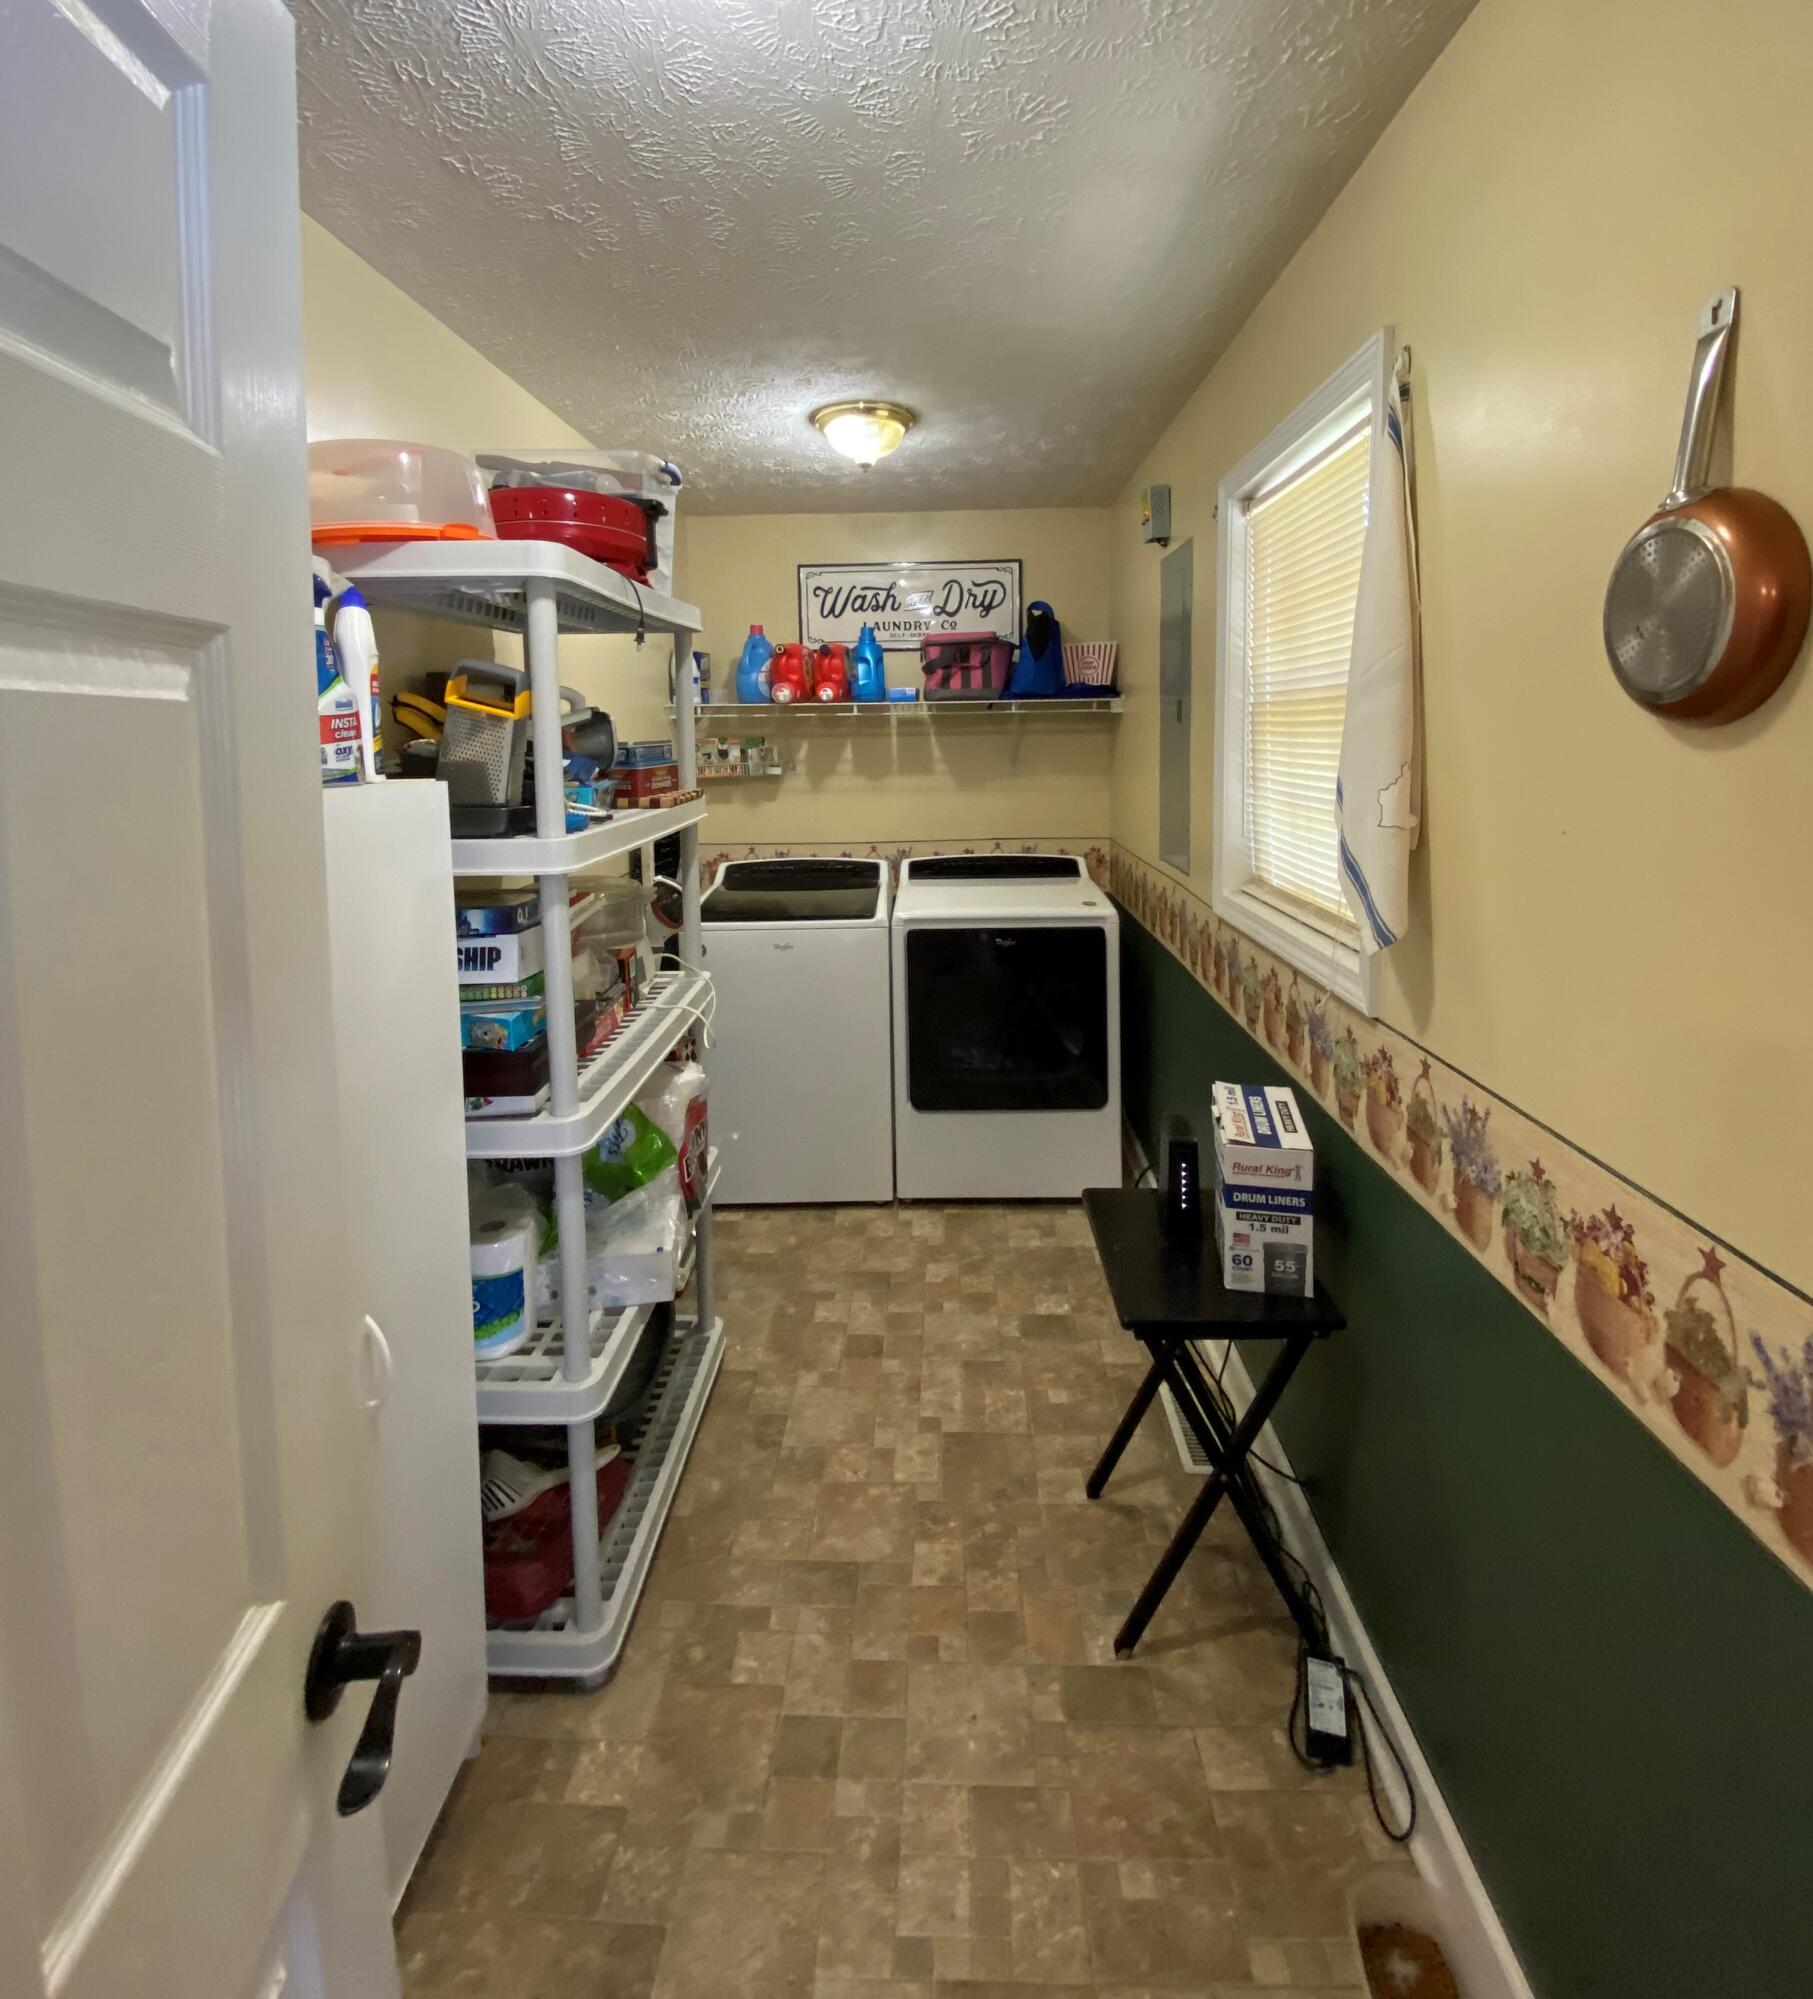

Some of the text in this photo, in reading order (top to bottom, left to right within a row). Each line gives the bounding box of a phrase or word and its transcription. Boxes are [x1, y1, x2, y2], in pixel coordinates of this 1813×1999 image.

[813, 581, 902, 619] Wash
[933, 579, 1007, 618] Dry
[863, 620, 932, 631] AUNDRY
[330, 717, 358, 729] INSTA
[334, 728, 357, 739] clean
[1231, 1162, 1262, 1174] Rural
[1265, 1164, 1292, 1178] King
[1232, 1192, 1306, 1208] DRUM LINERS
[1239, 1212, 1298, 1225] HEAVY DUTY
[1248, 1223, 1289, 1235] 1.5 mil
[1231, 1254, 1254, 1267] 60
[1273, 1259, 1297, 1273] 55
